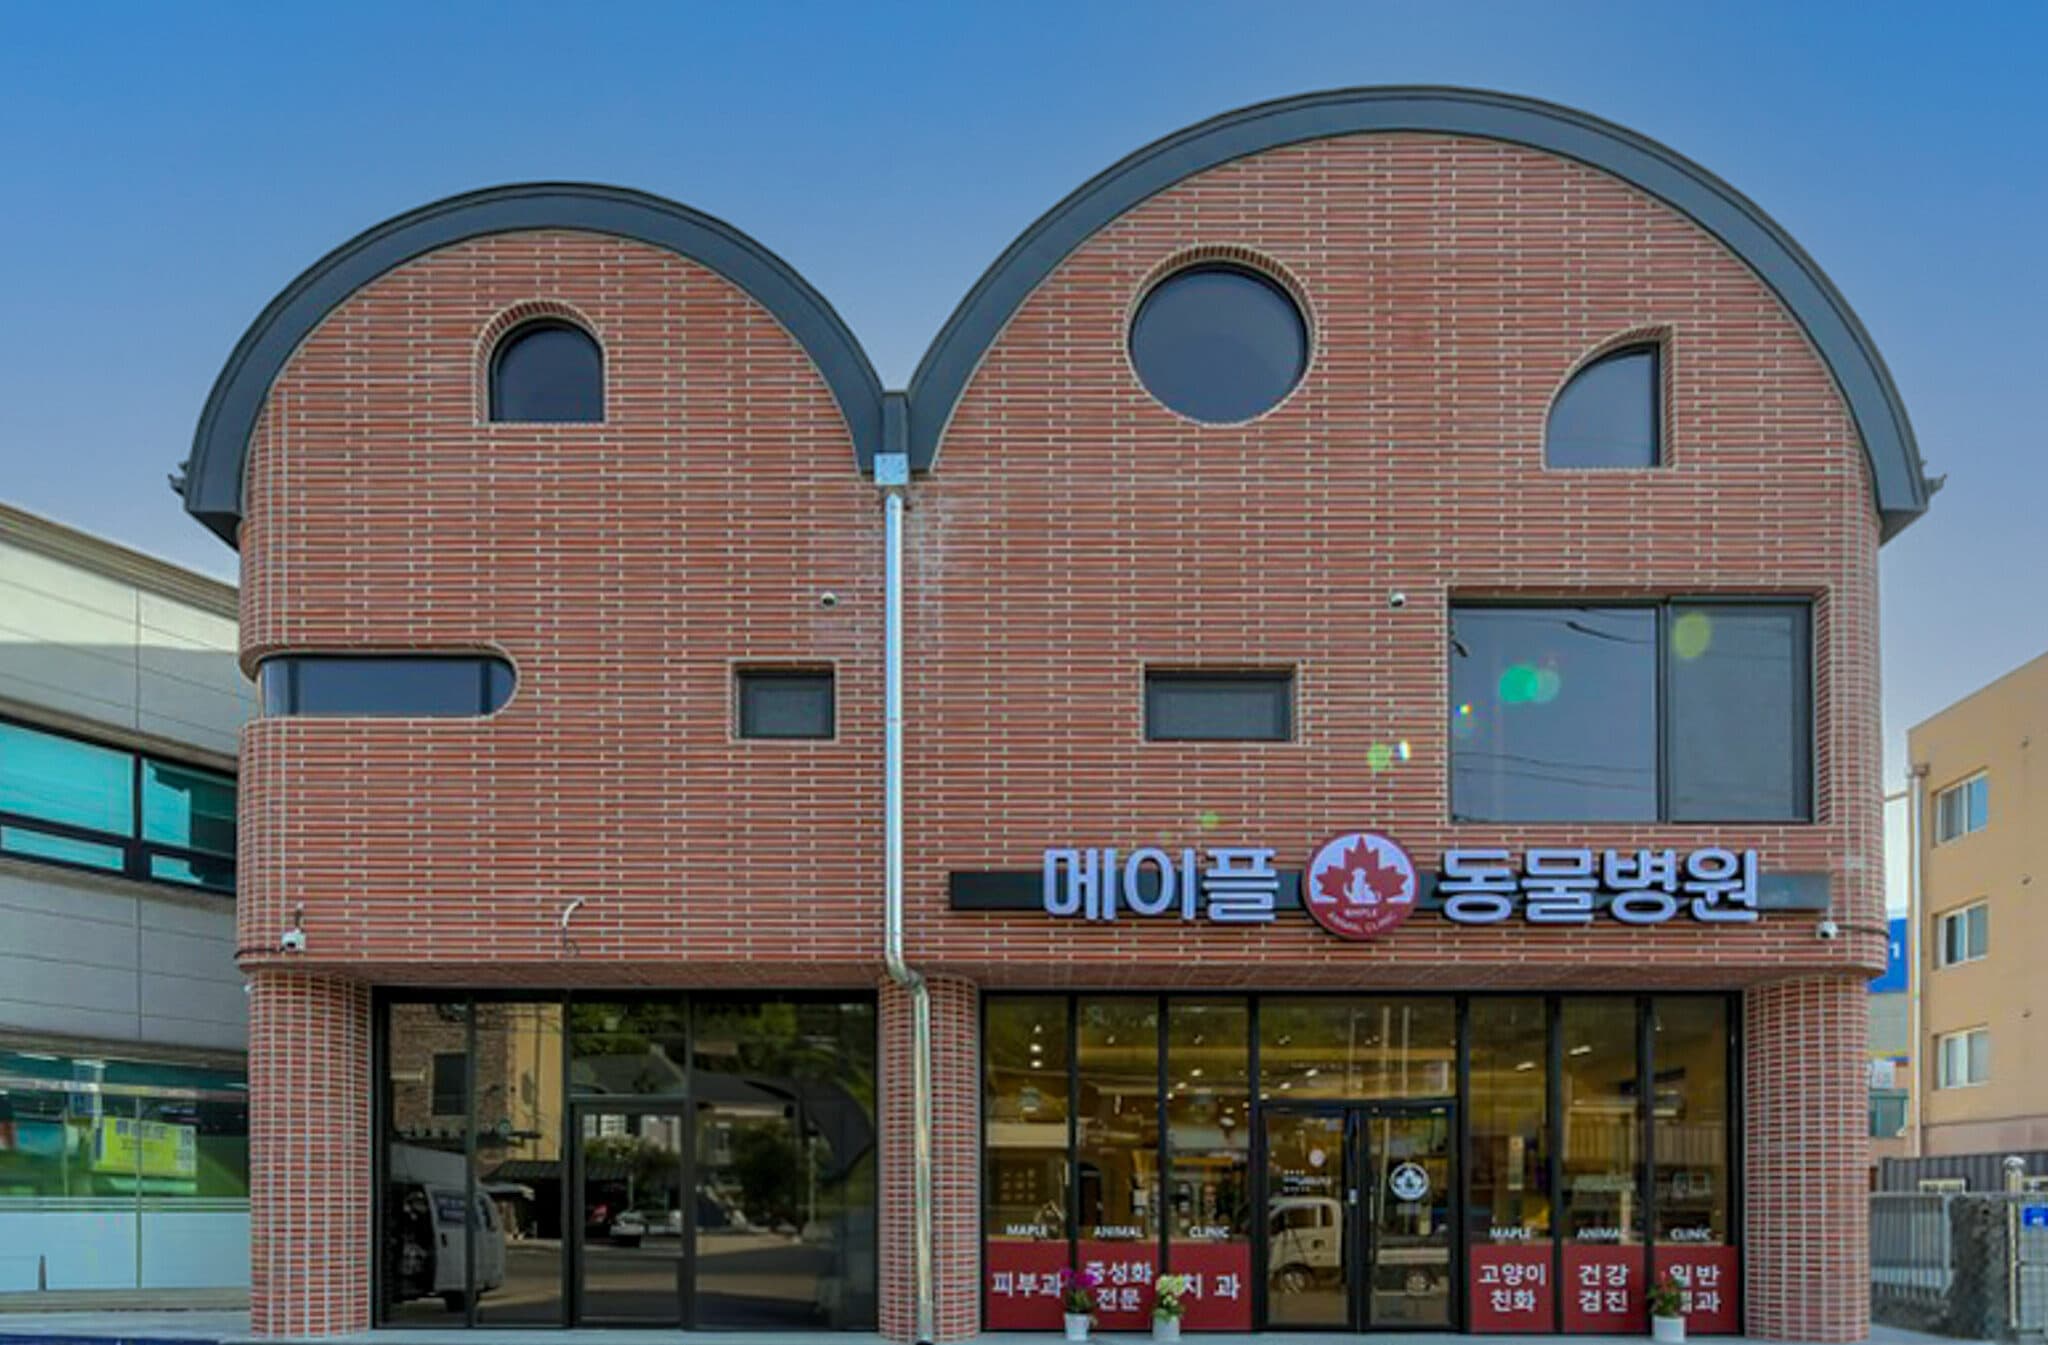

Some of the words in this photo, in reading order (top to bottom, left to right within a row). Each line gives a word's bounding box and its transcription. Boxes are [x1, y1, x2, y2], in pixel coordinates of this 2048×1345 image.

[1042, 847, 1280, 922] 메이플
[1439, 847, 1760, 924] 동물병원
[1006, 1224, 1048, 1237] MAPLE
[1093, 1225, 1144, 1238] ANIMAL
[1189, 1225, 1230, 1239] CLINIC
[1489, 1227, 1532, 1239] MAPLE
[1669, 1227, 1712, 1240] CLINIC
[992, 1271, 1064, 1297] 피부과
[1477, 1263, 1546, 1287] 고양이
[1578, 1263, 1630, 1287] 건강
[1096, 1287, 1141, 1312] 전문
[1490, 1288, 1536, 1313] 친화
[1578, 1289, 1629, 1313] 검진
